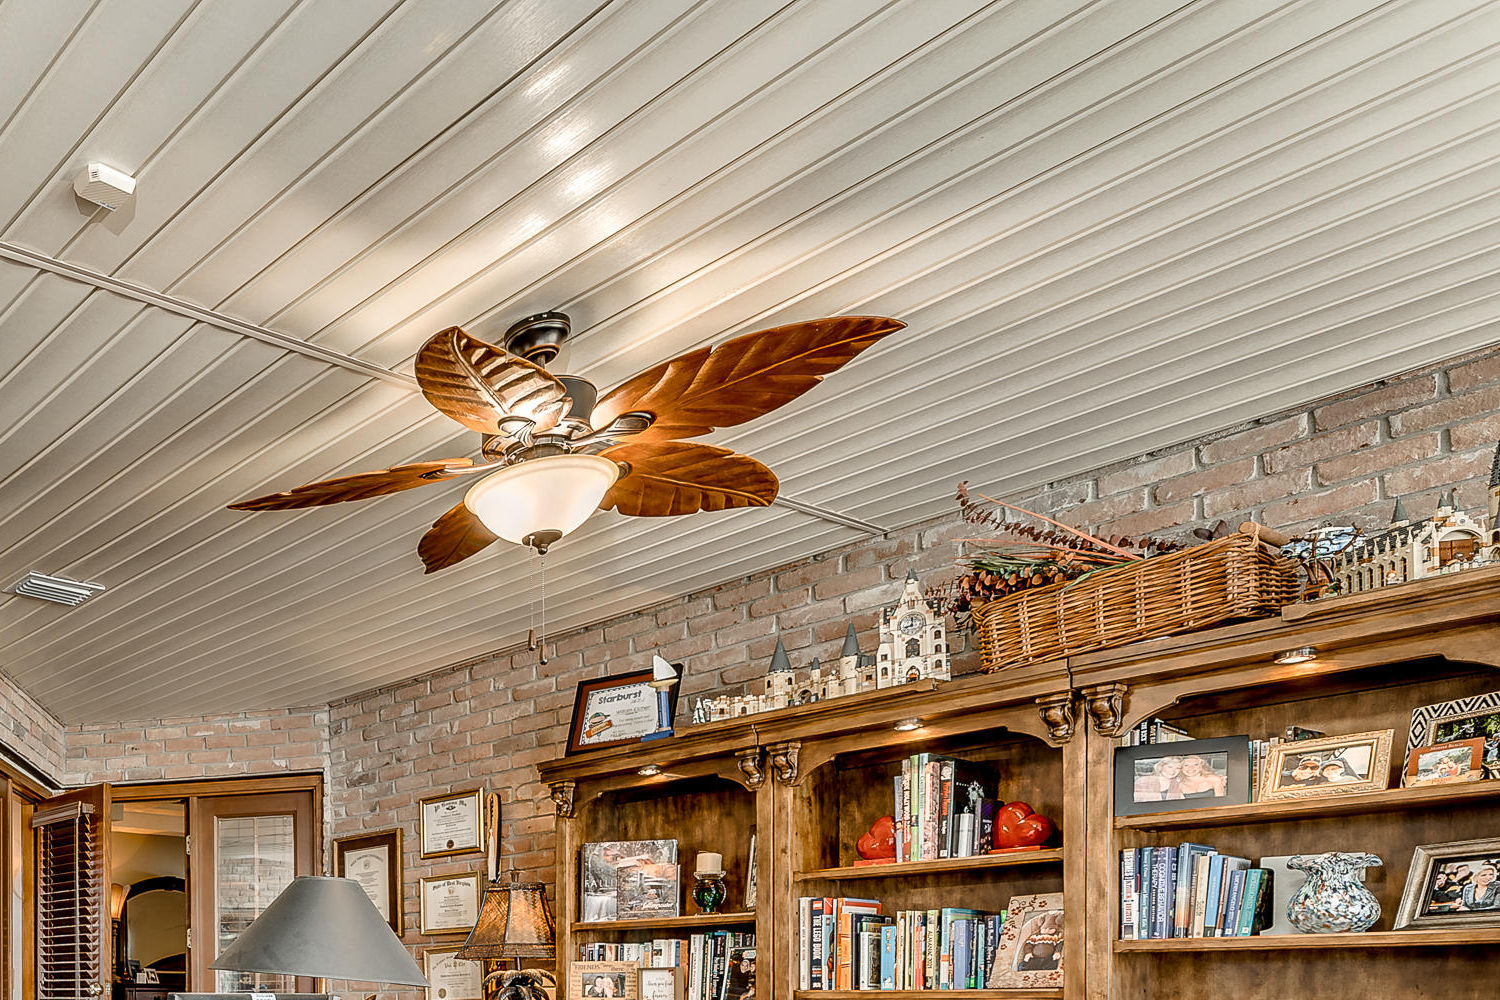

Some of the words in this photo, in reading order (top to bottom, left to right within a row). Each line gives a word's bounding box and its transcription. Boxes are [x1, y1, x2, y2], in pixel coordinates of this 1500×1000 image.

[598, 690, 642, 705] Starburst
[1158, 862, 1166, 893] COGNITIVE
[1157, 893, 1165, 923] BEHAVIOR
[813, 915, 822, 927] THE
[813, 928, 822, 942] LEGO
[813, 943, 822, 960] BOOK
